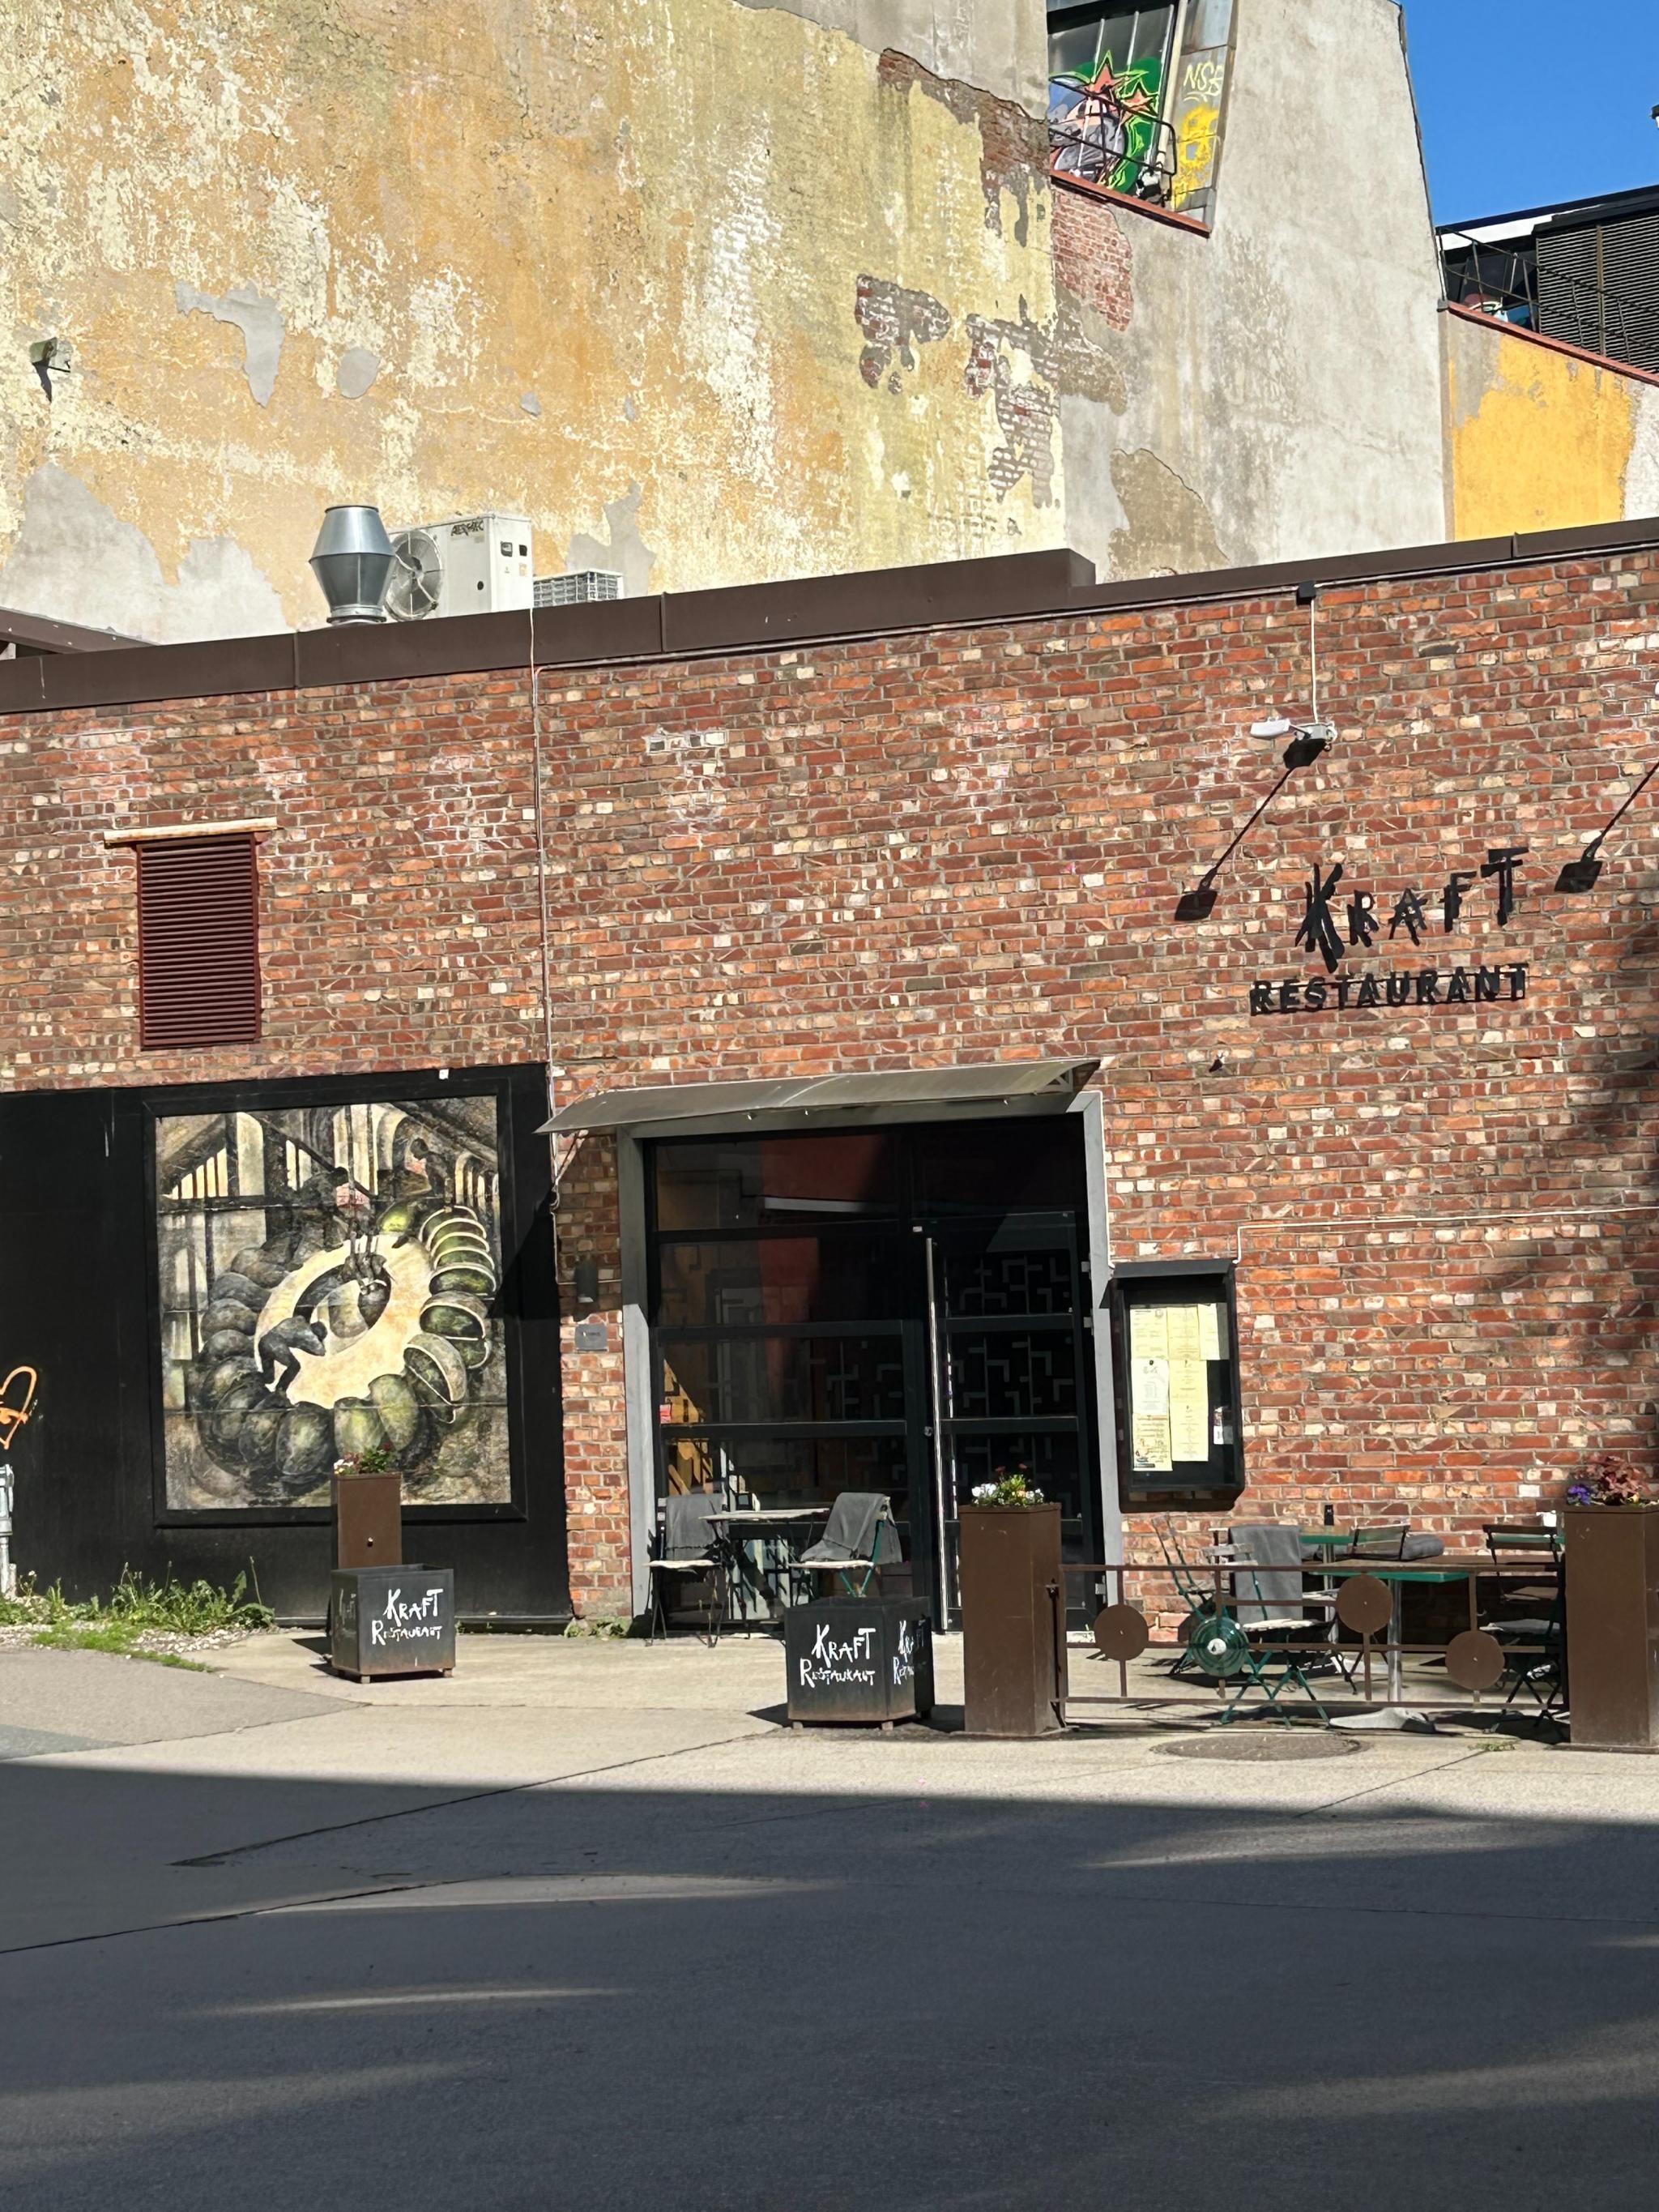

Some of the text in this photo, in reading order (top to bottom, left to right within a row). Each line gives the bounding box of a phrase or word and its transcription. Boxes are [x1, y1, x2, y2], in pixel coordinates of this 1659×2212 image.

[1295, 847, 1529, 973] KRAFT
[1250, 963, 1529, 1016] RESTAURANT
[382, 1588, 444, 1627] KRAFT
[811, 1624, 876, 1668] KRAFT
